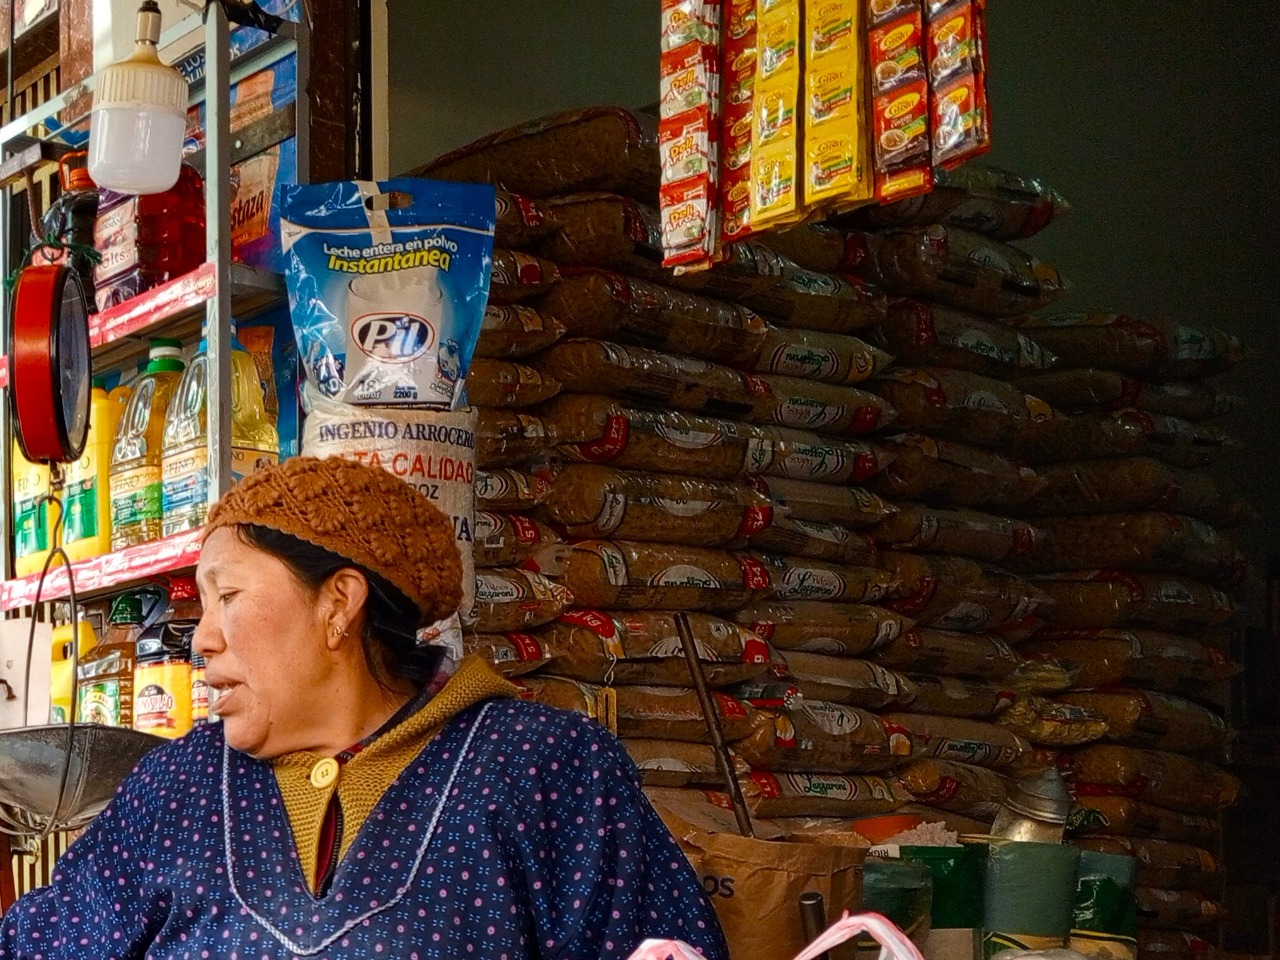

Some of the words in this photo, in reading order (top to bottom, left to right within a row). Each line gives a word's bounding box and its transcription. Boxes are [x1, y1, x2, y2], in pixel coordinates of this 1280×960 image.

[670, 135, 695, 156] Deli
[670, 203, 695, 223] Deli
[323, 243, 361, 259] Leche
[362, 242, 404, 257] entera
[405, 239, 424, 251] en
[425, 235, 458, 253] polvo
[362, 315, 420, 356] Pil
[393, 390, 411, 399] 2200
[320, 420, 398, 443] INGENIO
